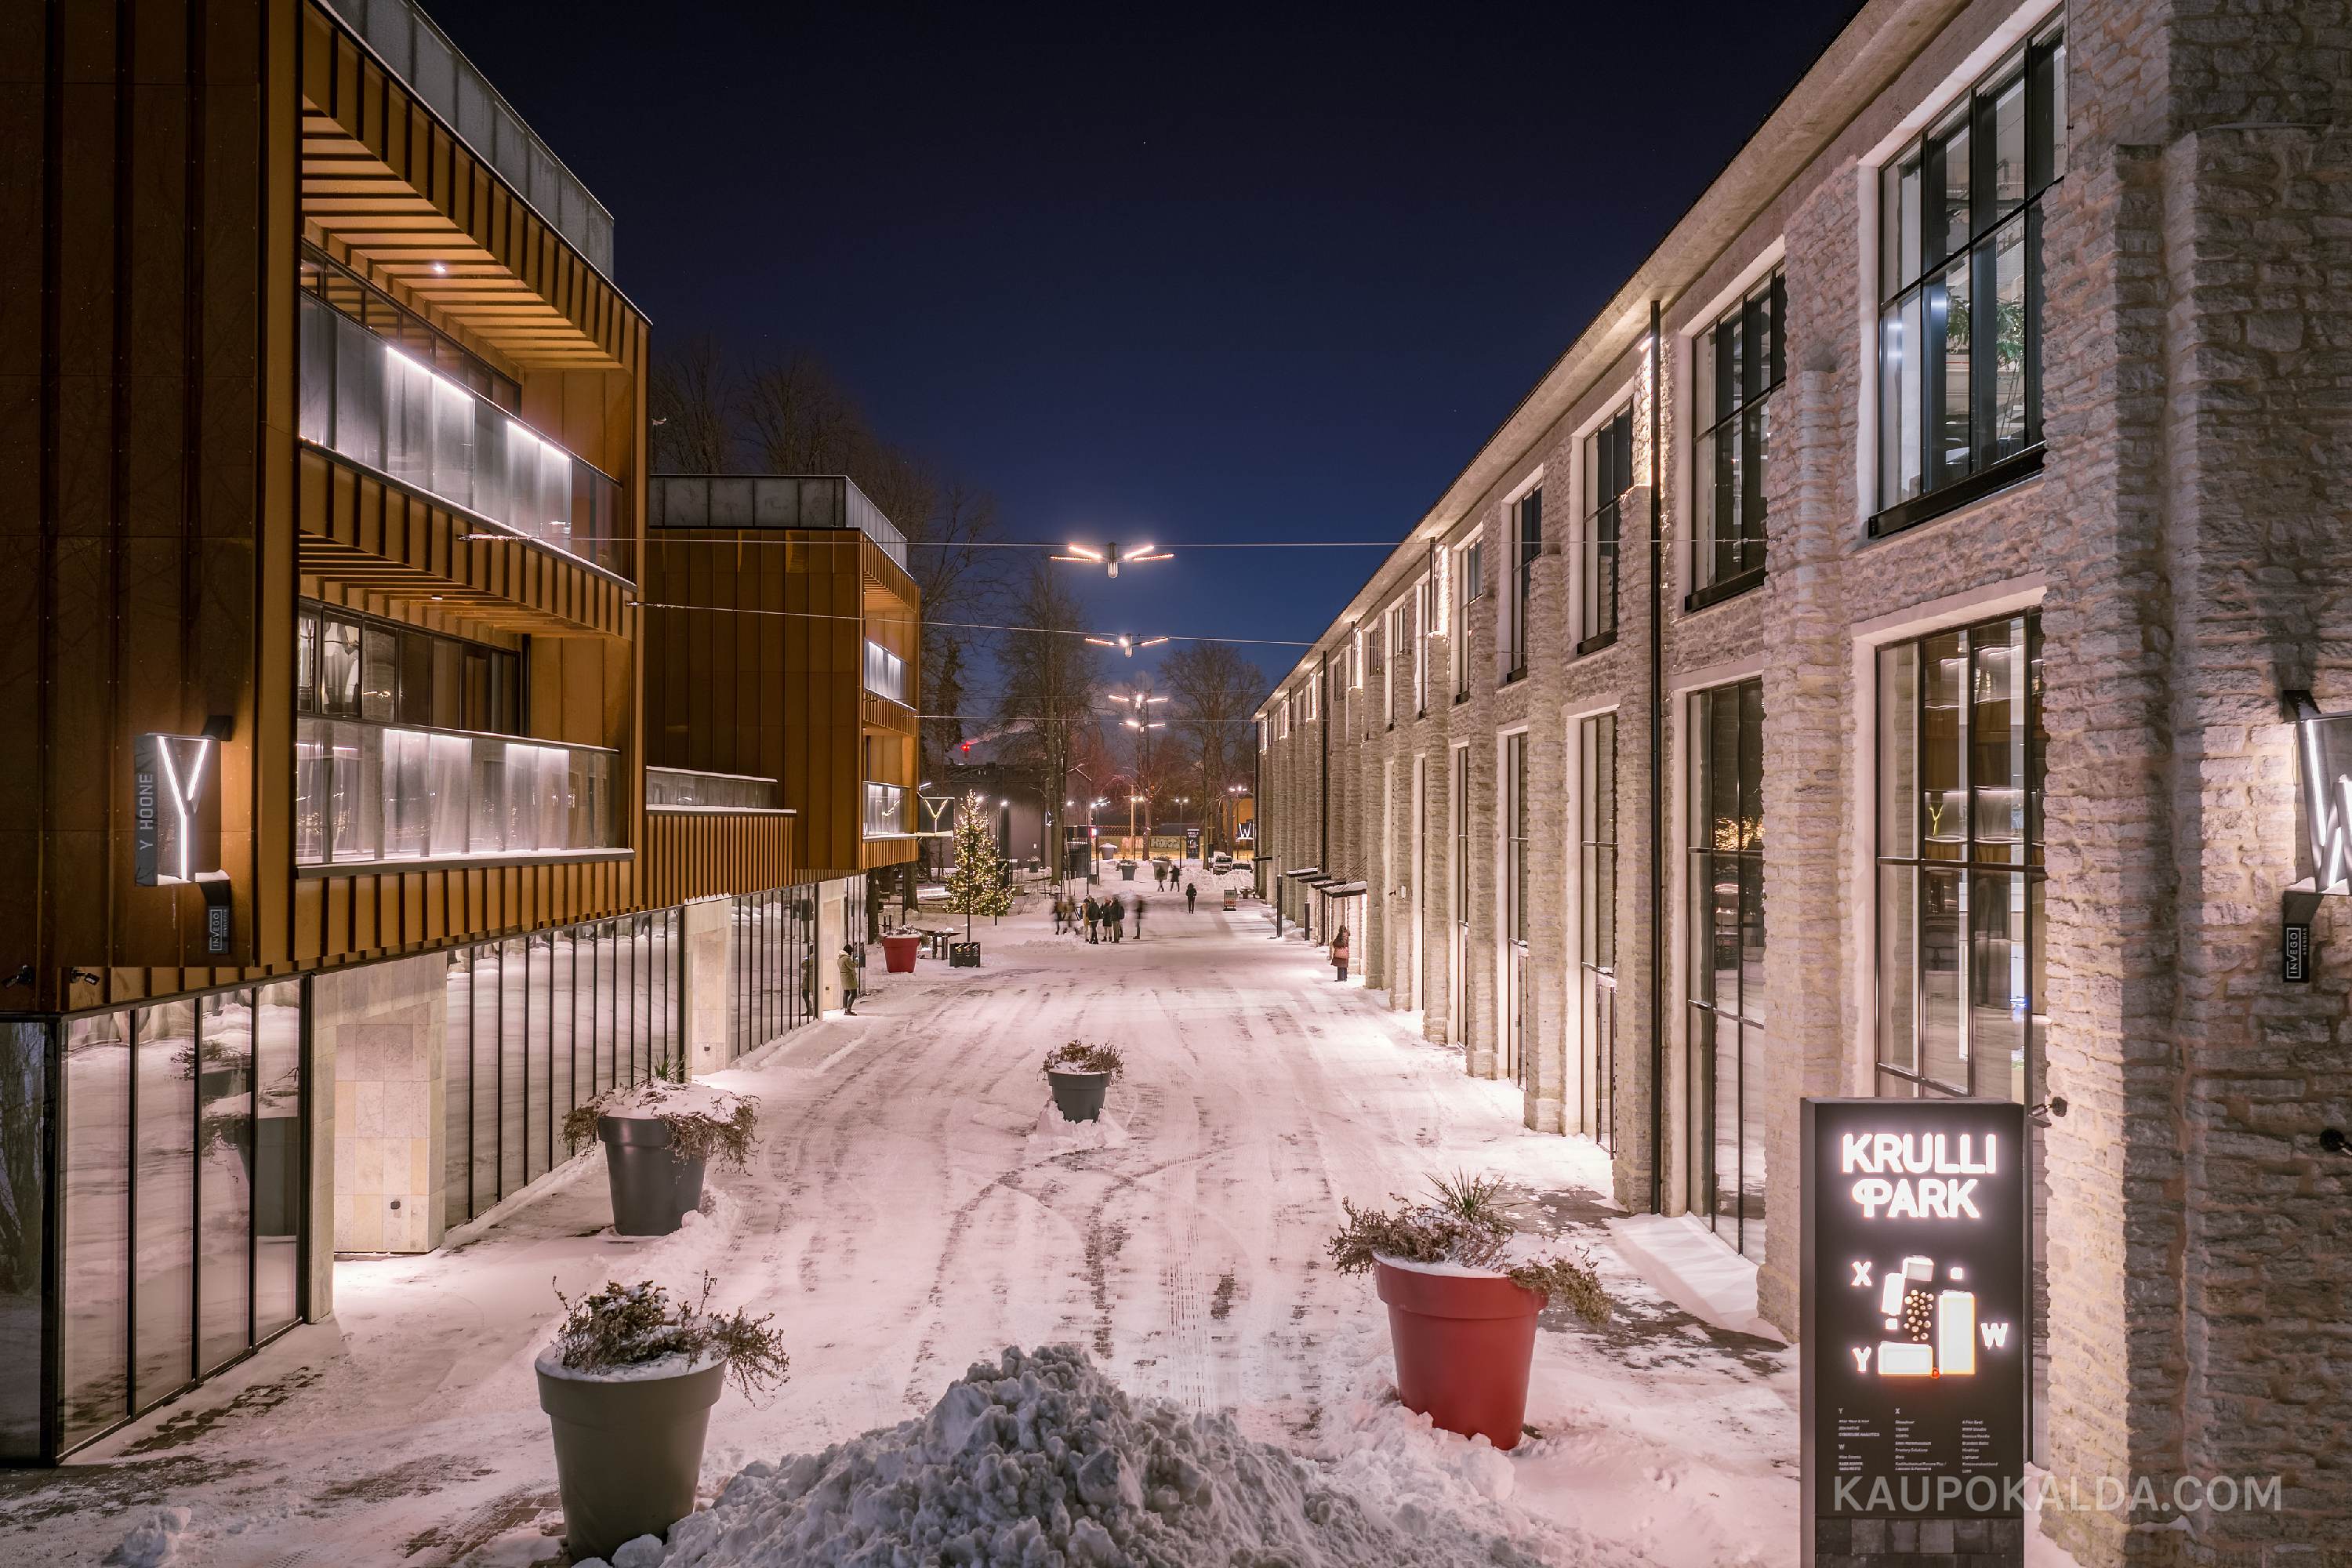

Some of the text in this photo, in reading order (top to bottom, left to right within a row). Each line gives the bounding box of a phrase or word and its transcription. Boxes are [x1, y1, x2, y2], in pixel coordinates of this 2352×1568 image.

[139, 771, 154, 851] Y HOONE
[158, 736, 209, 880] Y
[924, 798, 949, 834] Y
[1238, 822, 1252, 838] W
[212, 912, 220, 947] INVEGO
[2288, 932, 2298, 974] INVEGO
[1842, 1133, 1997, 1174] KRULLI
[1851, 1178, 1981, 1218] PARK
[1851, 1261, 1872, 1286] X
[1980, 1323, 2008, 1348] W
[1852, 1346, 1872, 1372] Y
